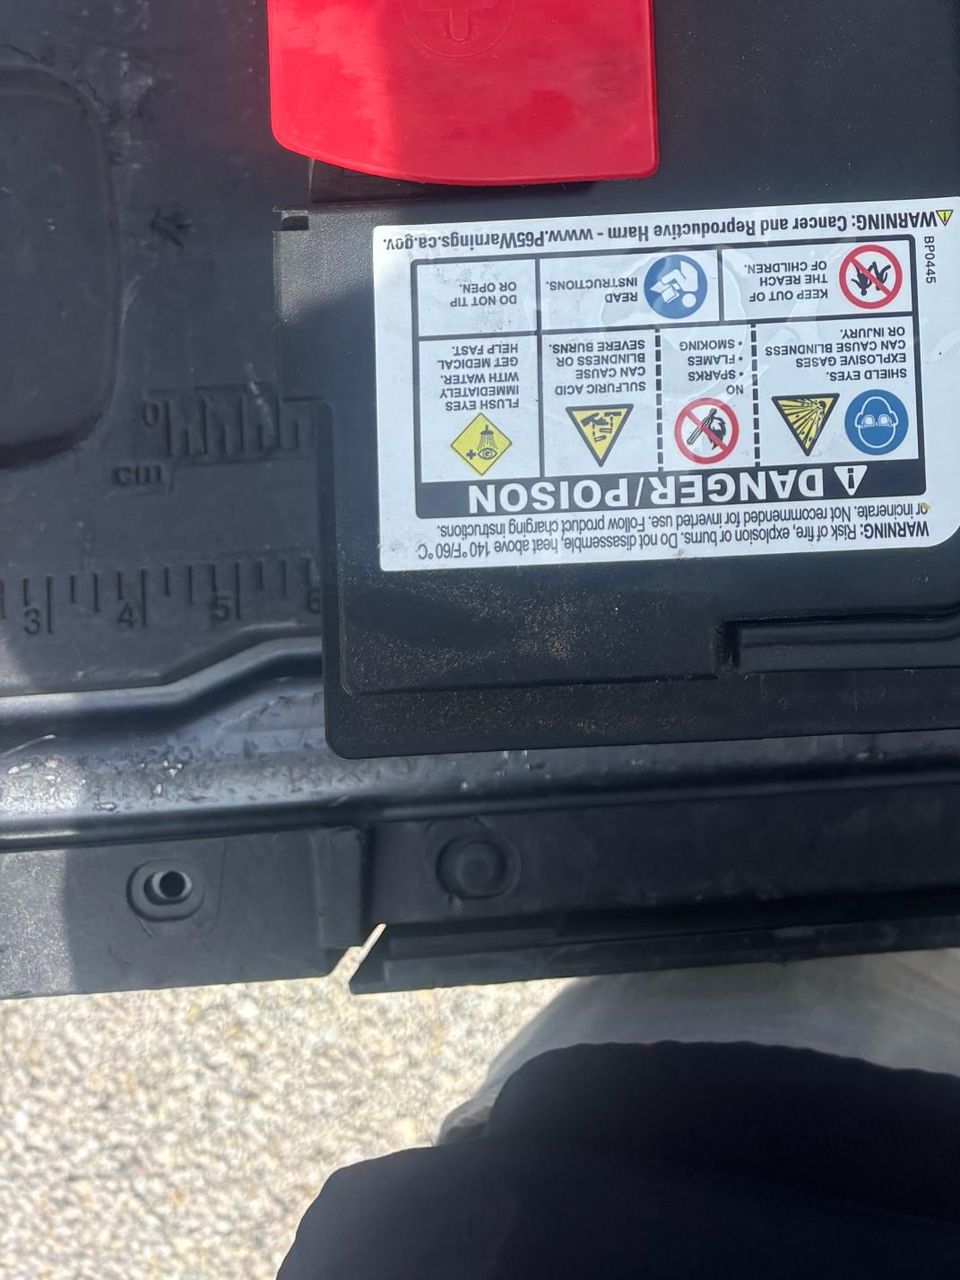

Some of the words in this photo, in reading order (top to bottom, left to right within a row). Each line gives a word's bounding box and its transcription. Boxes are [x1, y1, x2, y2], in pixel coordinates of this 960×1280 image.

[792, 215, 847, 232] Cancer
[851, 209, 940, 230] WARNING:
[653, 216, 755, 240] Reproductive
[760, 218, 788, 235] and
[607, 225, 648, 241] Harm
[923, 235, 936, 283] BP0445
[459, 282, 495, 293] OPEN.
[498, 281, 516, 291] OR
[545, 276, 637, 291] INSTRUCTIONS.
[449, 296, 468, 307] TIP
[470, 295, 496, 306] NOT
[499, 294, 517, 305] DO
[604, 291, 637, 303] READ
[678, 338, 735, 351] SMOKING
[687, 354, 735, 366] FLAMES
[795, 356, 836, 368] GASES
[839, 352, 906, 365] EXPLOSIVE
[687, 369, 736, 381] SPARKS
[825, 370, 860, 381] EYES.
[863, 367, 907, 379] SHIELD
[439, 384, 519, 398] IMMEDIATELY
[554, 384, 583, 395] ACID
[586, 381, 646, 394] SULFURIC
[725, 384, 743, 395] NO
[444, 400, 476, 411] EYES
[479, 397, 519, 409] FLUSH
[469, 468, 823, 513] DANGER/POISON
